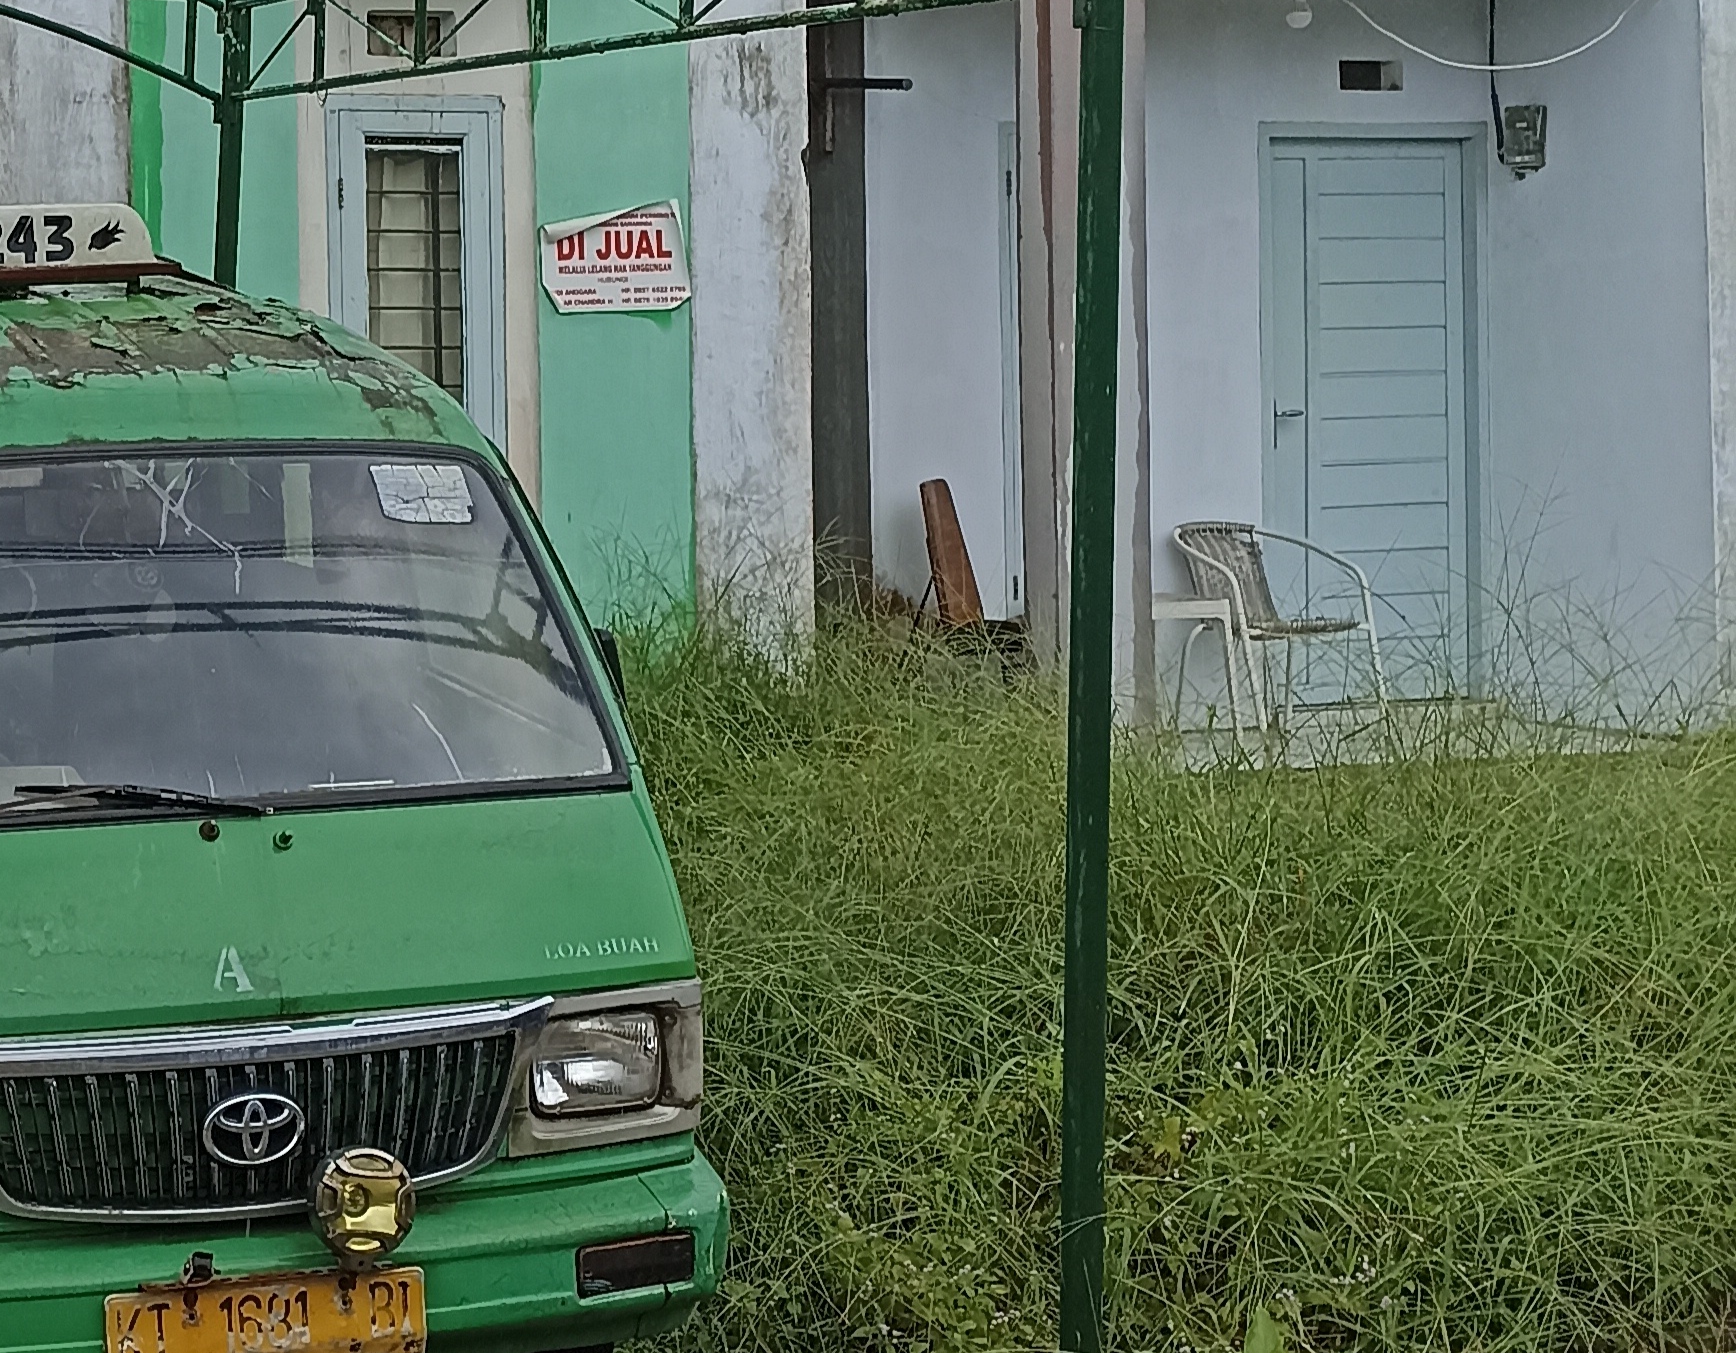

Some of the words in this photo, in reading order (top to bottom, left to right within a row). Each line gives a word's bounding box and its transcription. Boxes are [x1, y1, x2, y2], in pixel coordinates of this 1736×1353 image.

[556, 231, 586, 262] DI
[595, 229, 673, 261] JUAL
[587, 264, 613, 275] LELANG
[628, 262, 673, 274] TANGGUNGAN
[544, 941, 592, 960] LOA
[596, 936, 660, 957] BUAH
[213, 945, 255, 993] A
